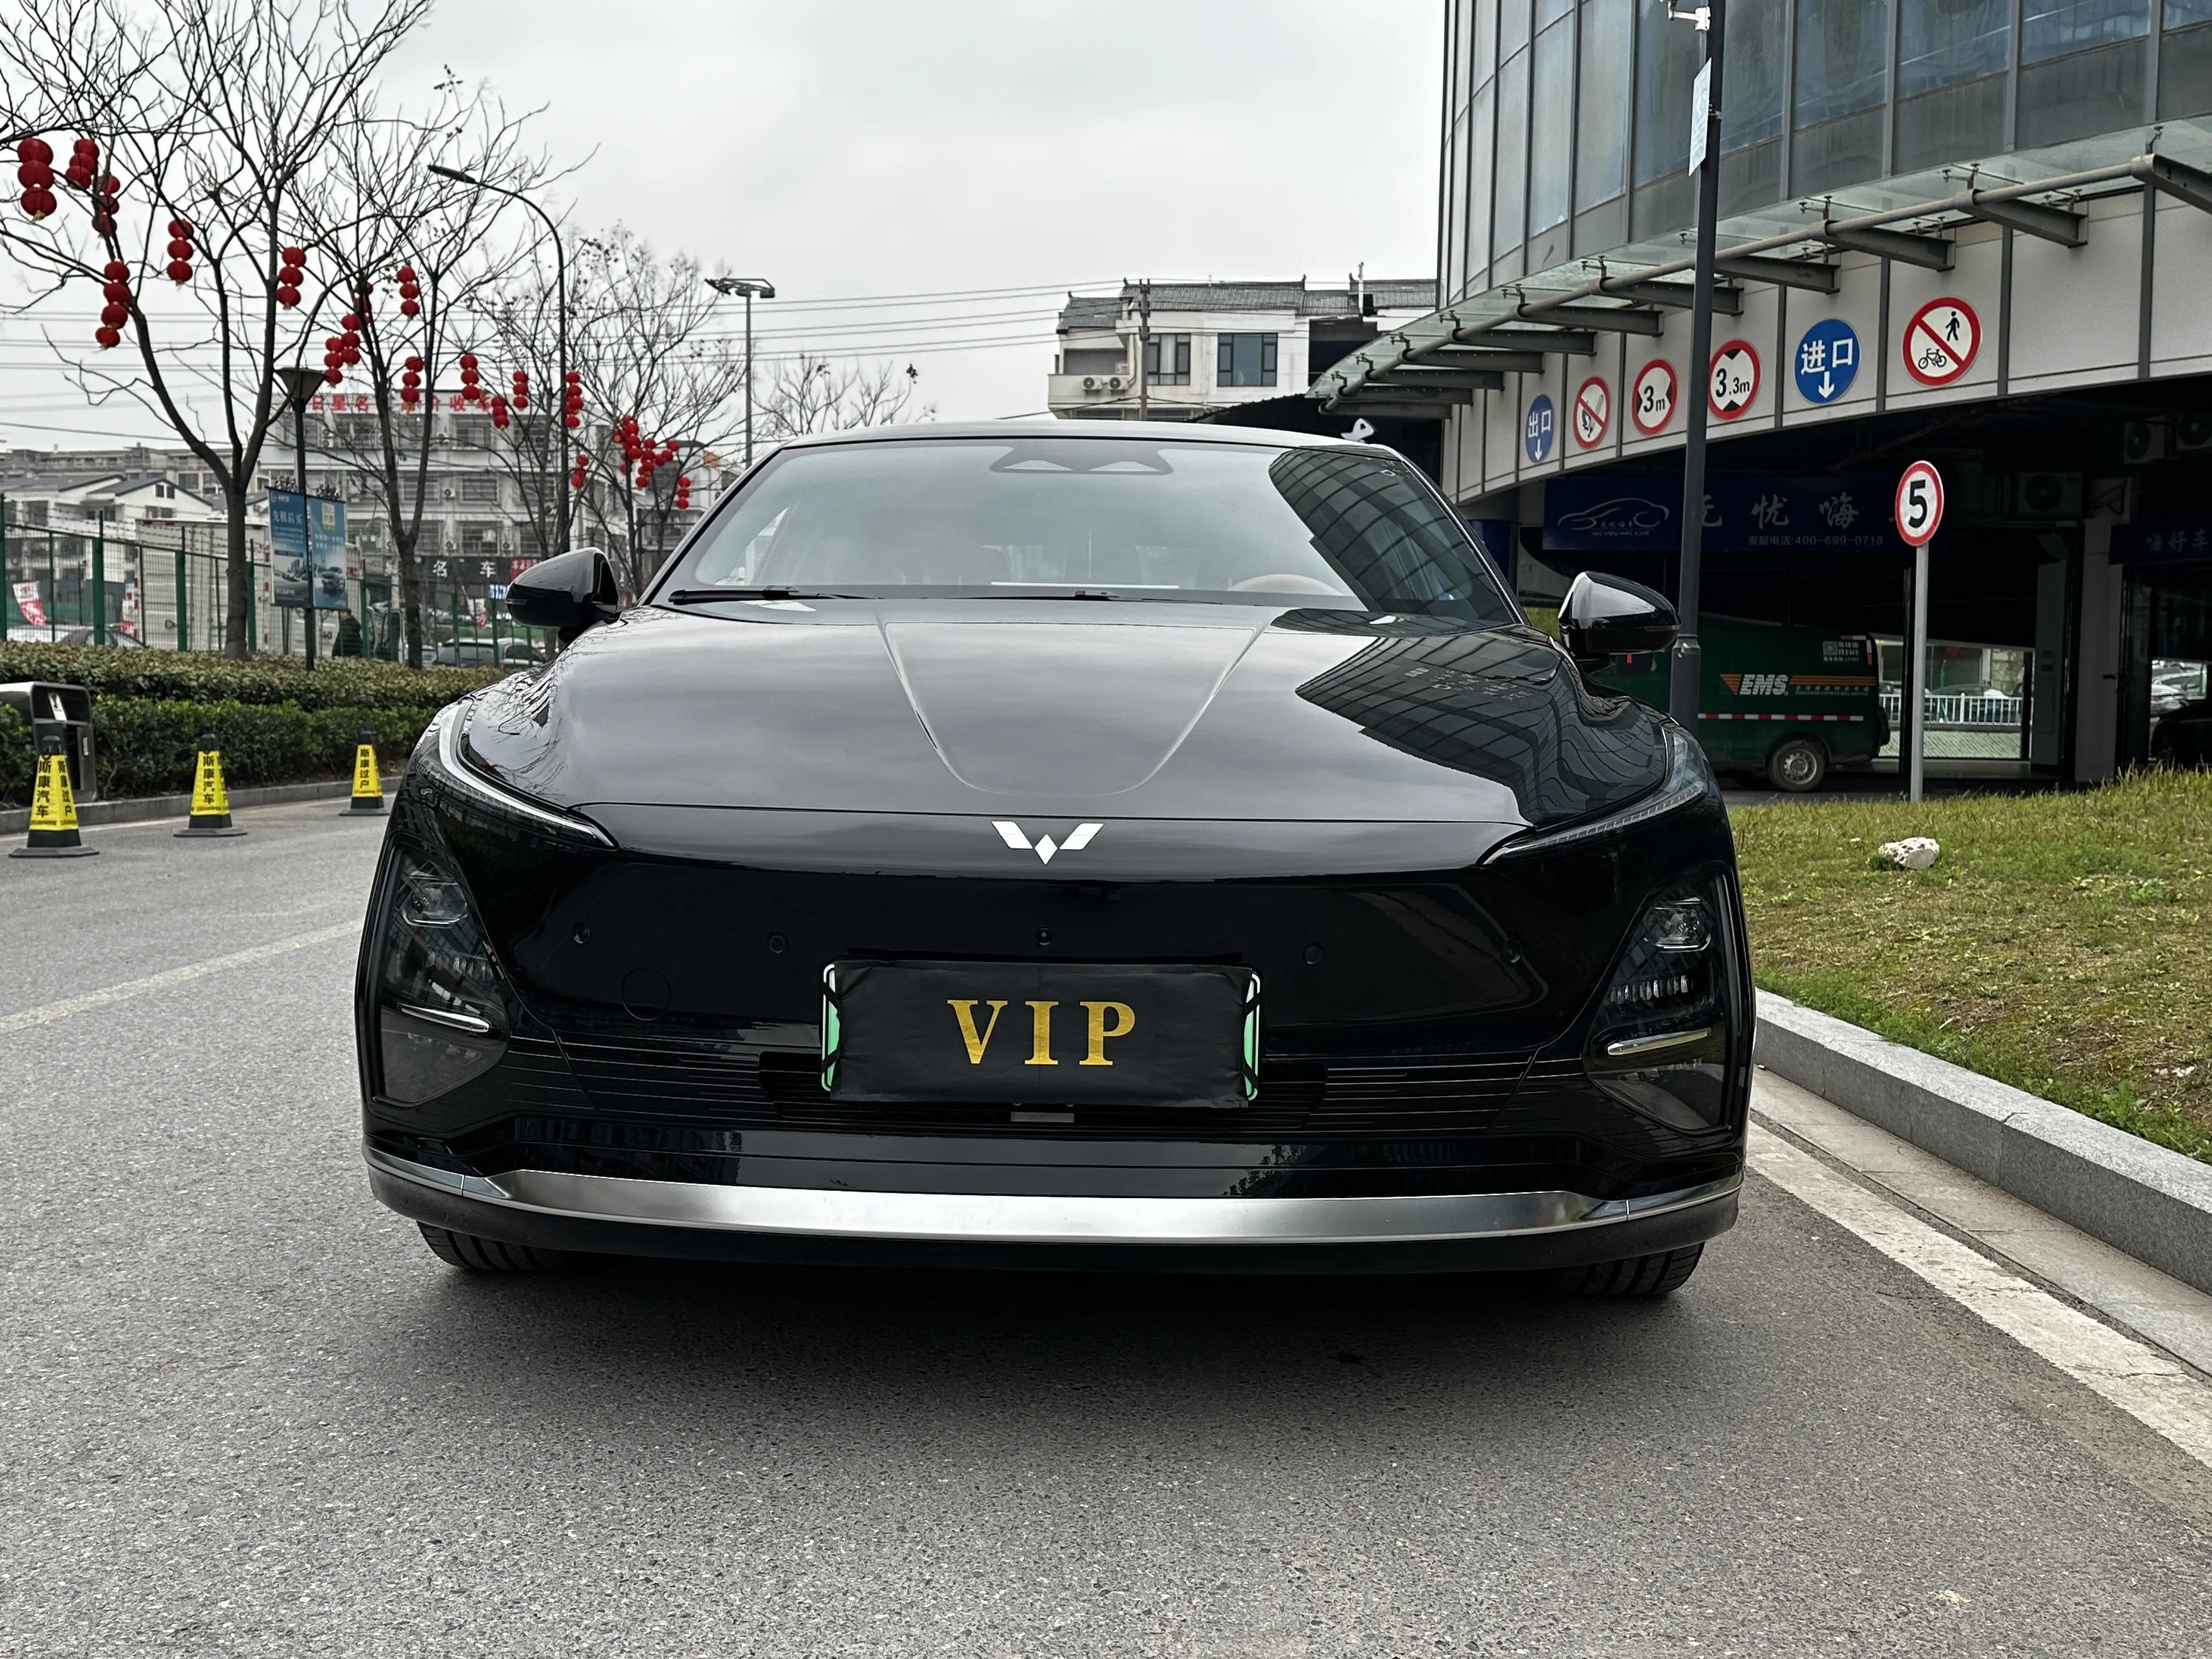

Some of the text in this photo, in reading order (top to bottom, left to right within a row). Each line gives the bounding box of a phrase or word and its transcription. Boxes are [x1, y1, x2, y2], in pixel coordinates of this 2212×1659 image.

[1801, 338, 1853, 375] 进口
[1715, 368, 1750, 397] 3.3m
[1643, 385, 1666, 413] 3m
[1528, 409, 1551, 438] 出口
[1908, 479, 1928, 529] 5
[1739, 674, 1789, 696] EMS
[947, 999, 1136, 1066] VIP
